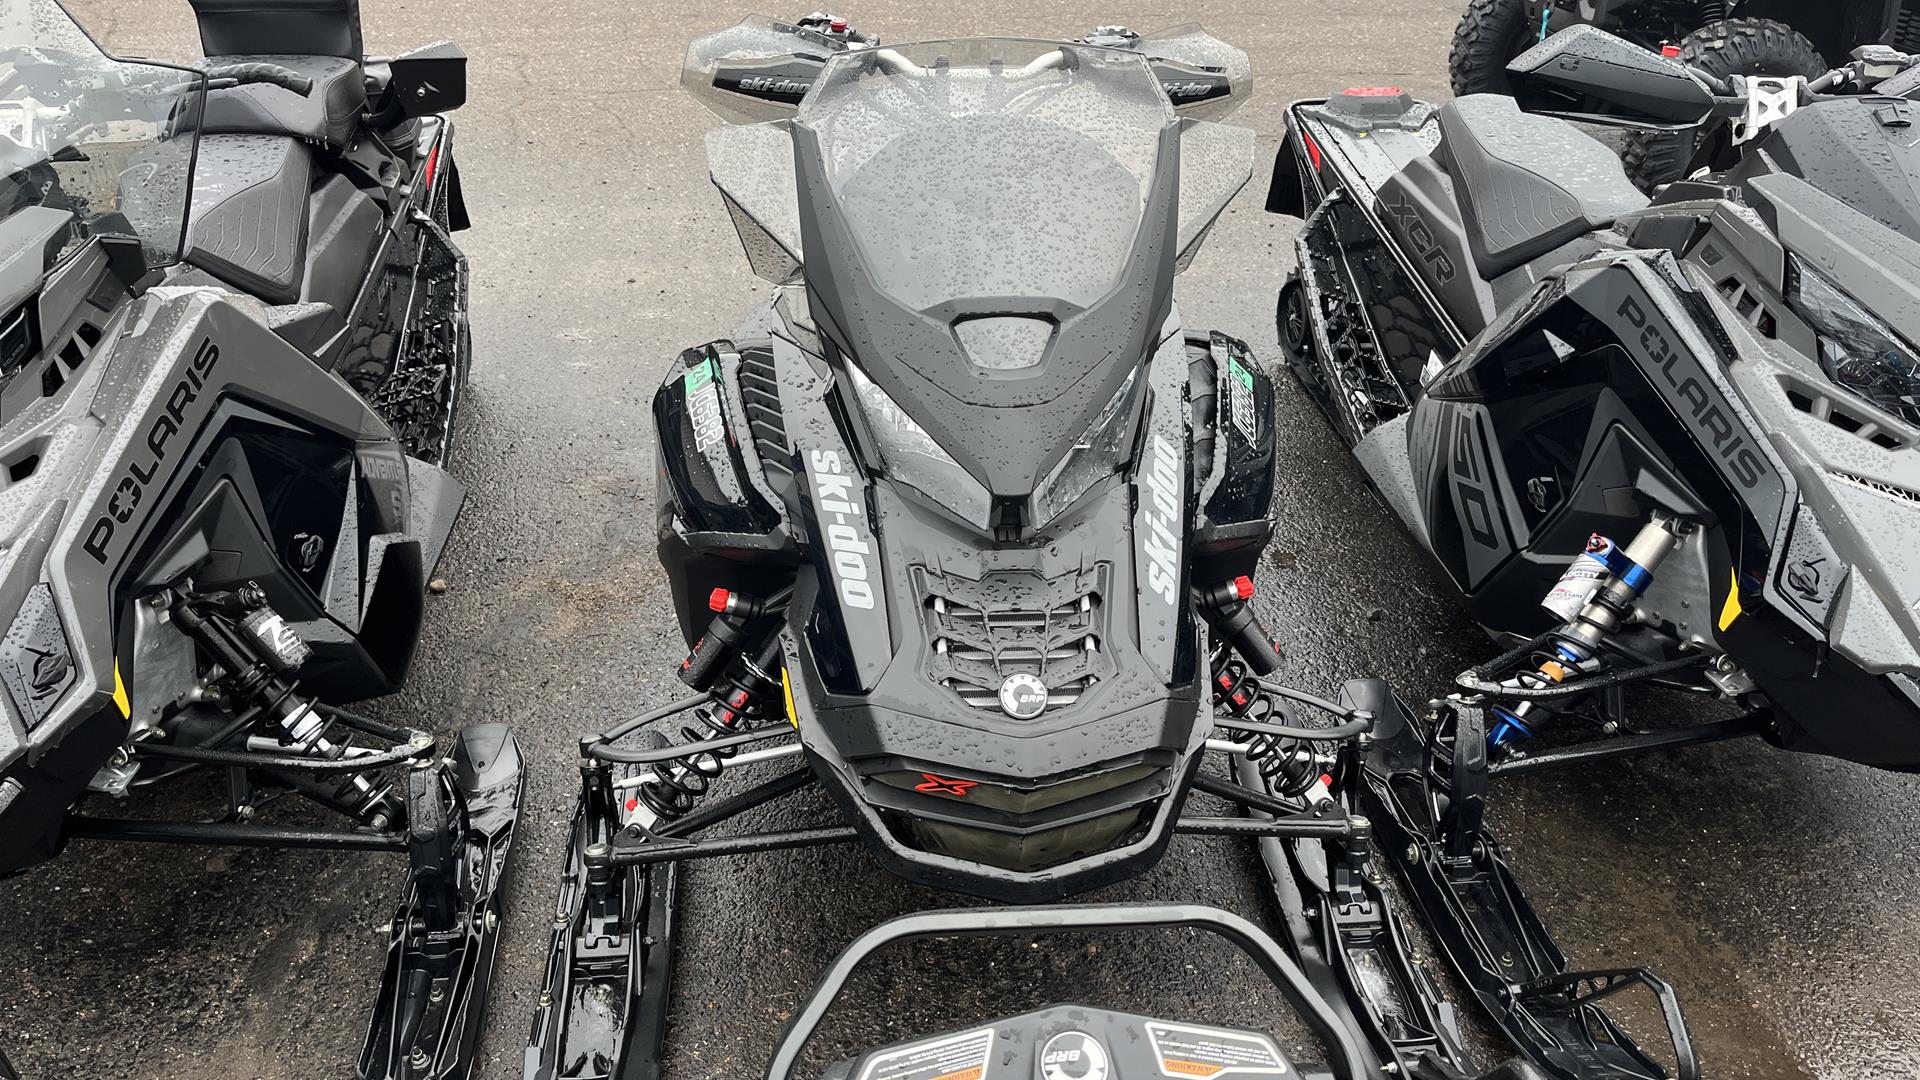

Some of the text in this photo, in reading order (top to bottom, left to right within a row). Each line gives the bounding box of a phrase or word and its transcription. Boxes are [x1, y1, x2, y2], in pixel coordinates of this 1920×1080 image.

[739, 77, 811, 94] ski-doo
[1163, 82, 1212, 97] ki-doo
[1387, 189, 1456, 287] XCR
[688, 382, 725, 453] JC6382
[1616, 294, 1767, 489] POLARIS
[82, 336, 220, 565] POLARIS
[811, 450, 875, 610] ski-doo
[1144, 434, 1178, 605] ski-doo
[1020, 694, 1044, 703] BRP
[1045, 1049, 1080, 1064] BRP
